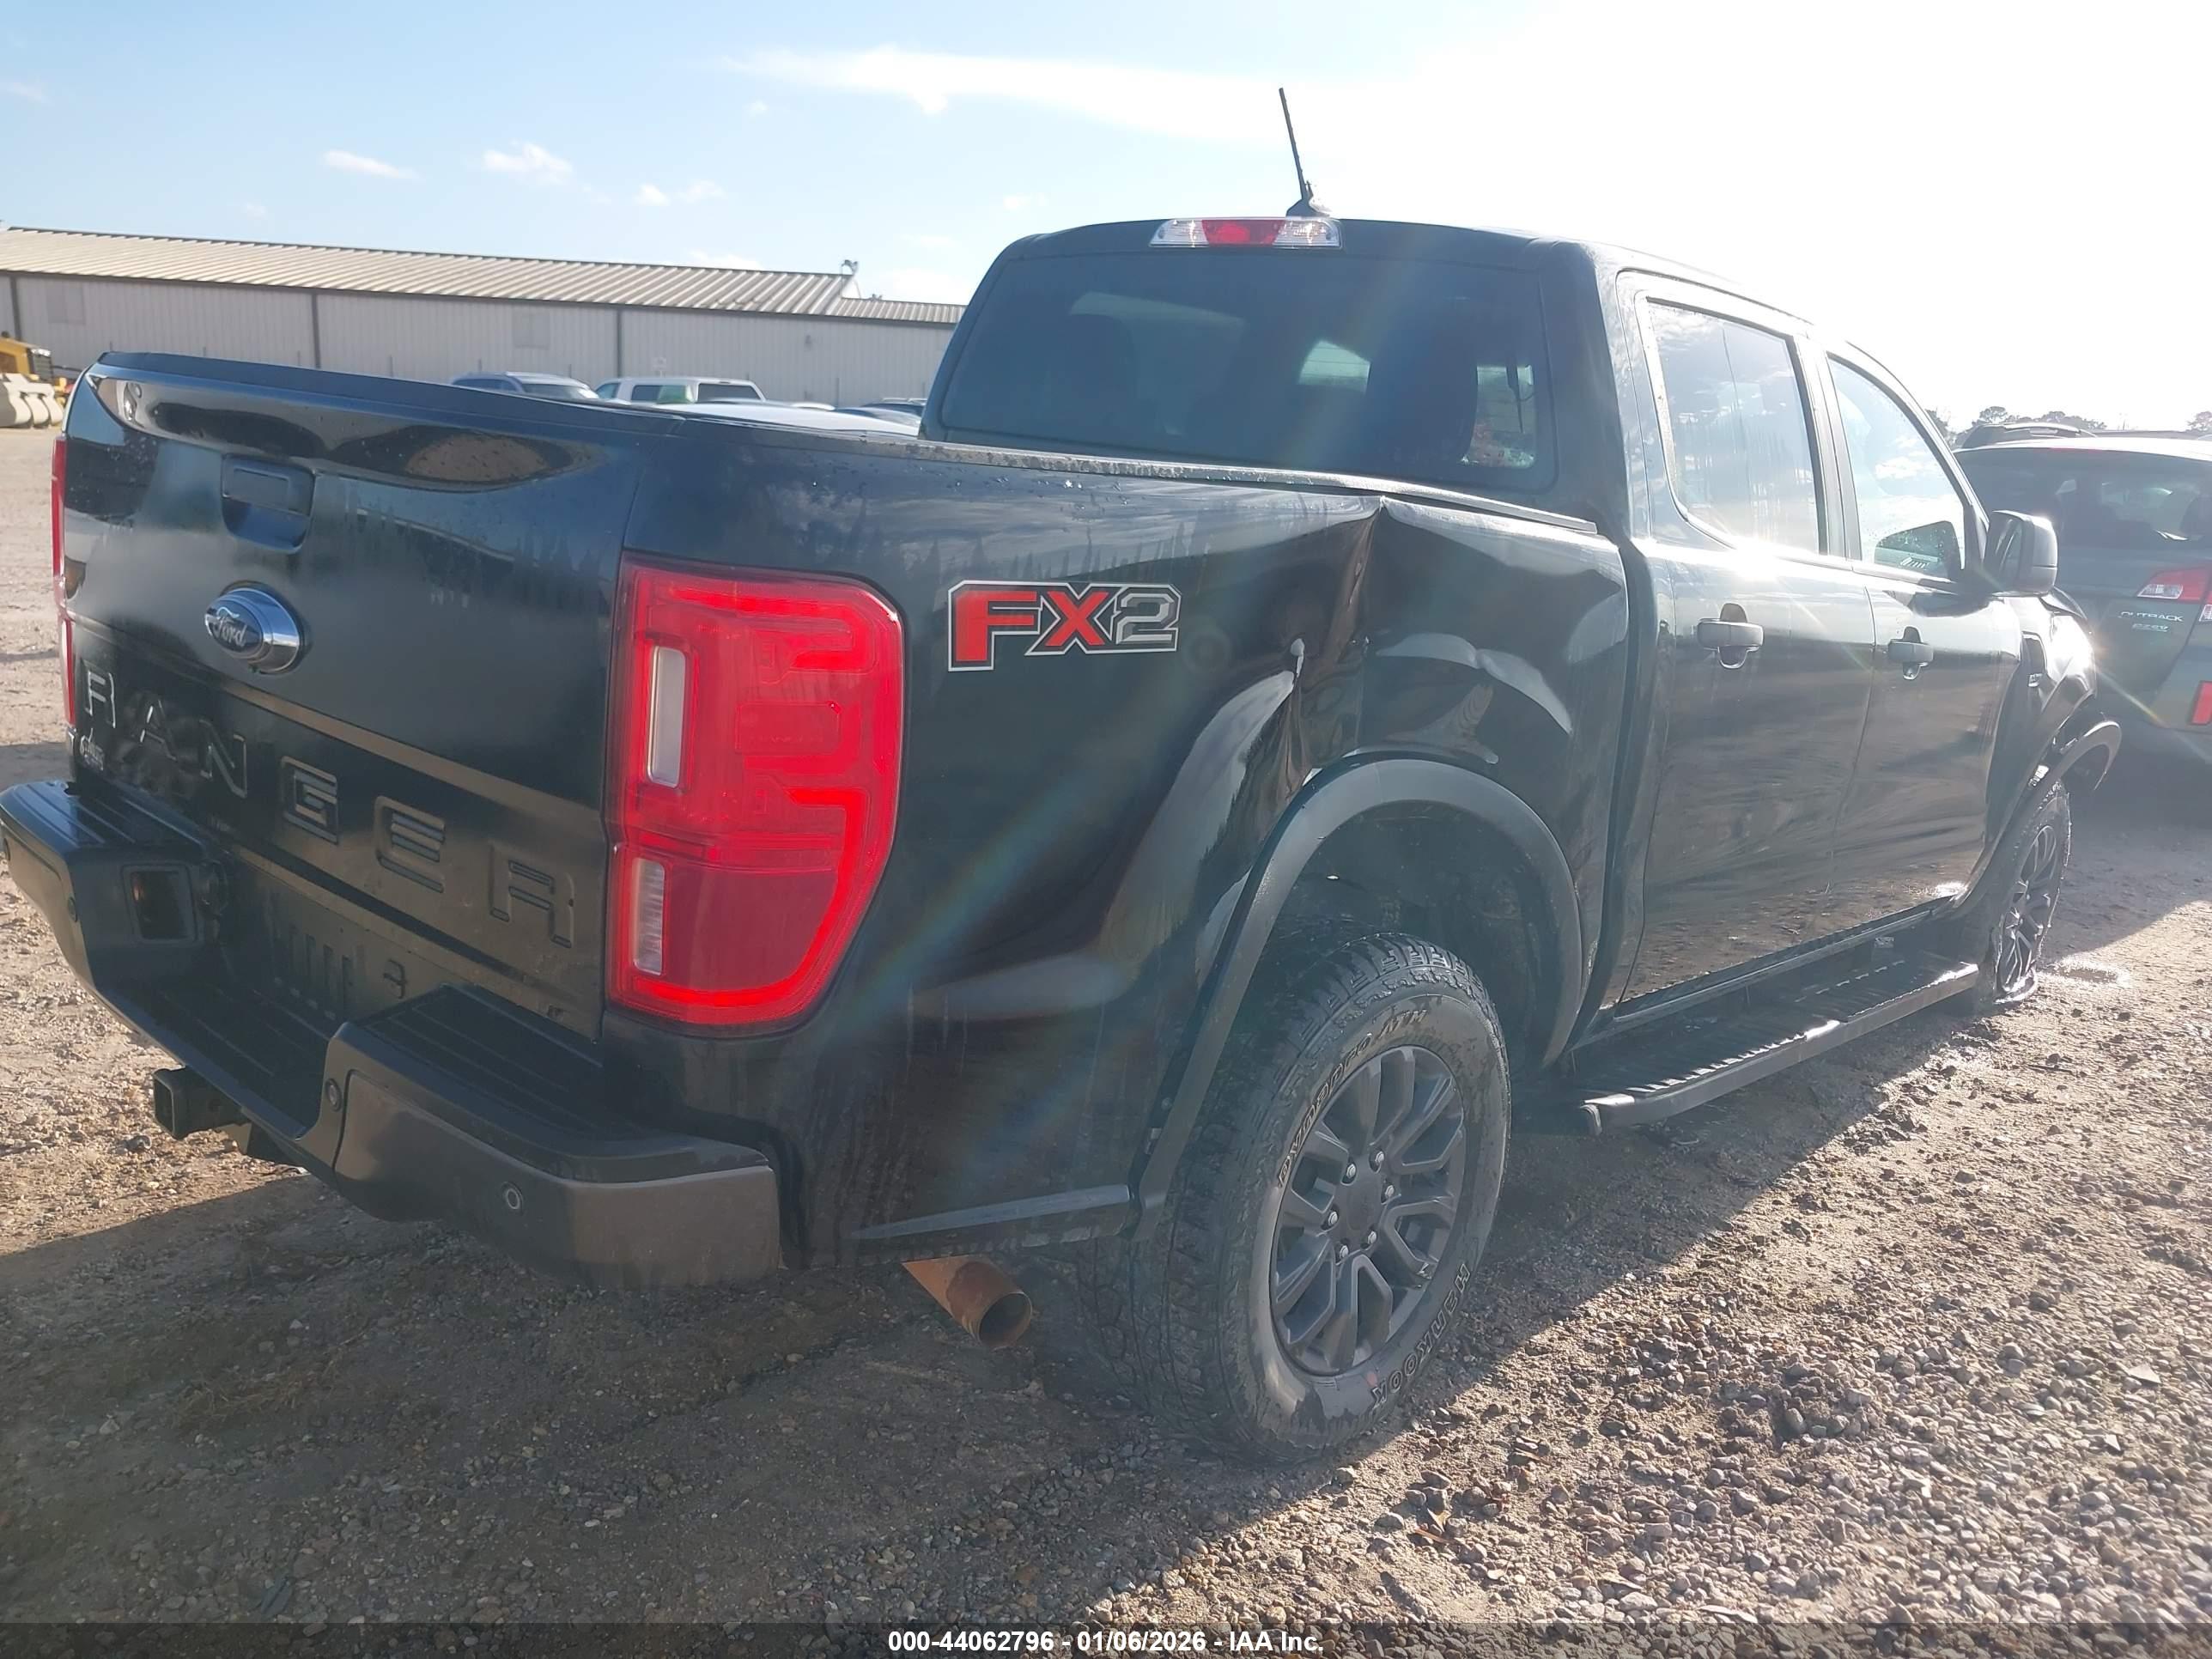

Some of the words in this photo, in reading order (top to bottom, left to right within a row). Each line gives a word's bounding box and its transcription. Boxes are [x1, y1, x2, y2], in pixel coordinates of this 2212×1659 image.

[213, 606, 248, 648] Ford
[948, 580, 1182, 672] FX2
[82, 665, 576, 950] RANGER
